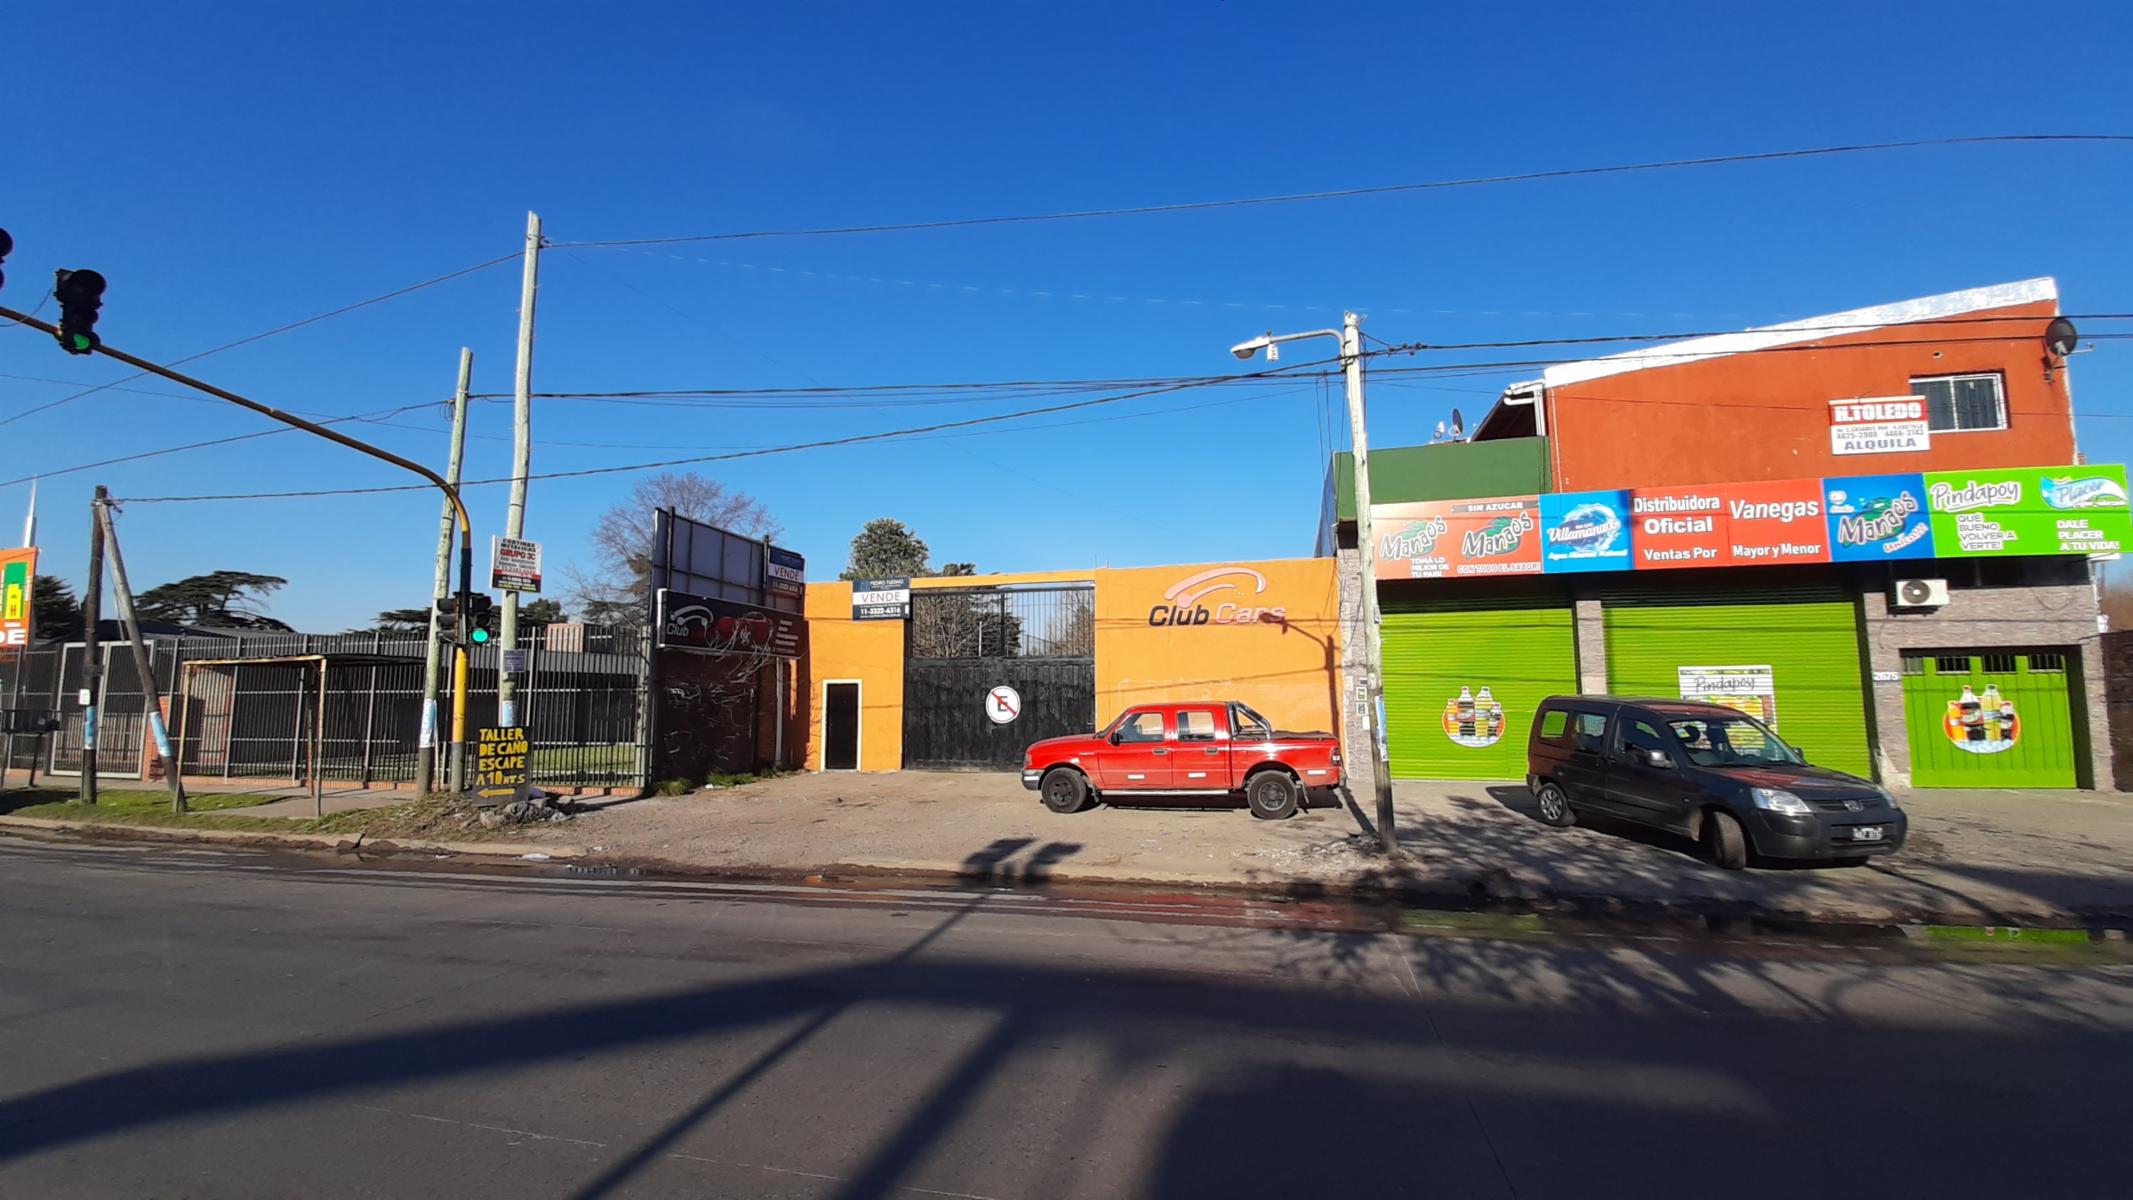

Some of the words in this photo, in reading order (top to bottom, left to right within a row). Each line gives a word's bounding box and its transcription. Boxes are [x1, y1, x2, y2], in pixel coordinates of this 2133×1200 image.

[1844, 438, 1917, 450] ALQUILA
[1931, 481, 2021, 510] Pindapoy
[1468, 504, 1483, 512] SIN
[1633, 495, 1721, 513] Distribuidora
[1729, 499, 1819, 523] Vanegas
[1644, 516, 1713, 534] Oficial
[1838, 491, 1919, 545] Manaos
[2056, 520, 2088, 528] DALE
[1462, 511, 1534, 558] Manaos
[1959, 523, 1999, 532] BUENO
[2058, 530, 2104, 539] PLACER
[1380, 515, 1447, 560] Manaos
[1960, 532, 2003, 540] VOLVER
[2006, 531, 2016, 540] A
[1732, 544, 1771, 558] Mayor
[1771, 545, 1780, 558] y
[1780, 543, 1822, 555] Menor
[2060, 542, 2070, 550] A
[2070, 541, 2087, 550] TU
[1644, 548, 1691, 561] Ventas
[1693, 547, 1717, 558] Por
[774, 566, 800, 580] VENDE
[1457, 564, 1475, 573] CON
[861, 592, 901, 603] VENDE
[1148, 604, 1210, 626] Club
[1215, 602, 1286, 624] Cars
[666, 622, 689, 636] Club
[1694, 677, 1755, 693] Pindapoy
[997, 696, 1008, 712] E
[480, 728, 524, 741] TALLER
[479, 743, 496, 757] DE
[479, 756, 525, 771] ESCAPE
